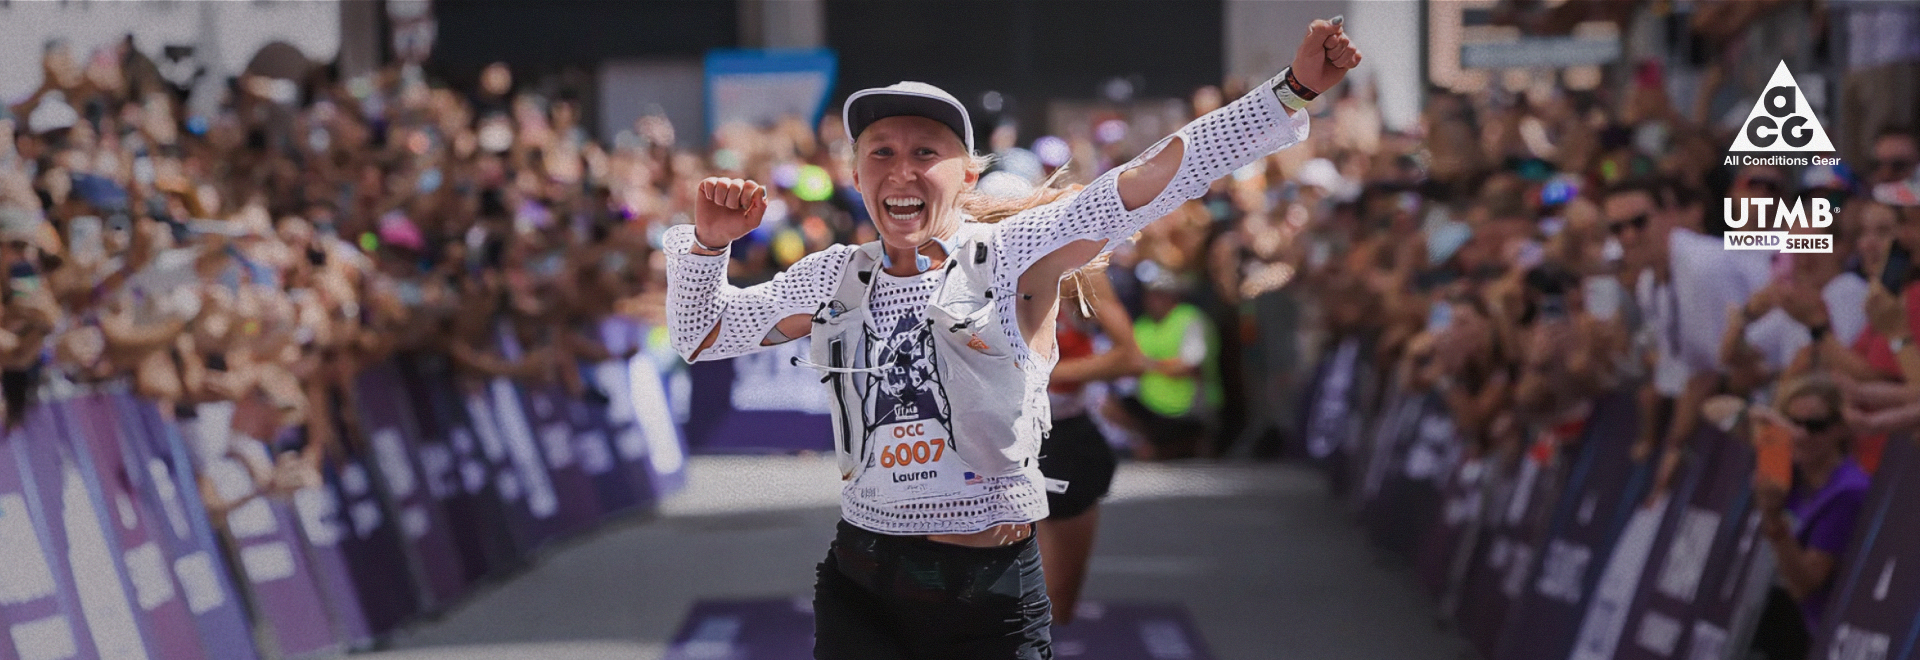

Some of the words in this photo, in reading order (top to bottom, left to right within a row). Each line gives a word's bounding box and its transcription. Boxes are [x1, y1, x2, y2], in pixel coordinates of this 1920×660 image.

[893, 424, 924, 438] OCC
[880, 438, 945, 468] 6007
[892, 470, 937, 483] Lauren
